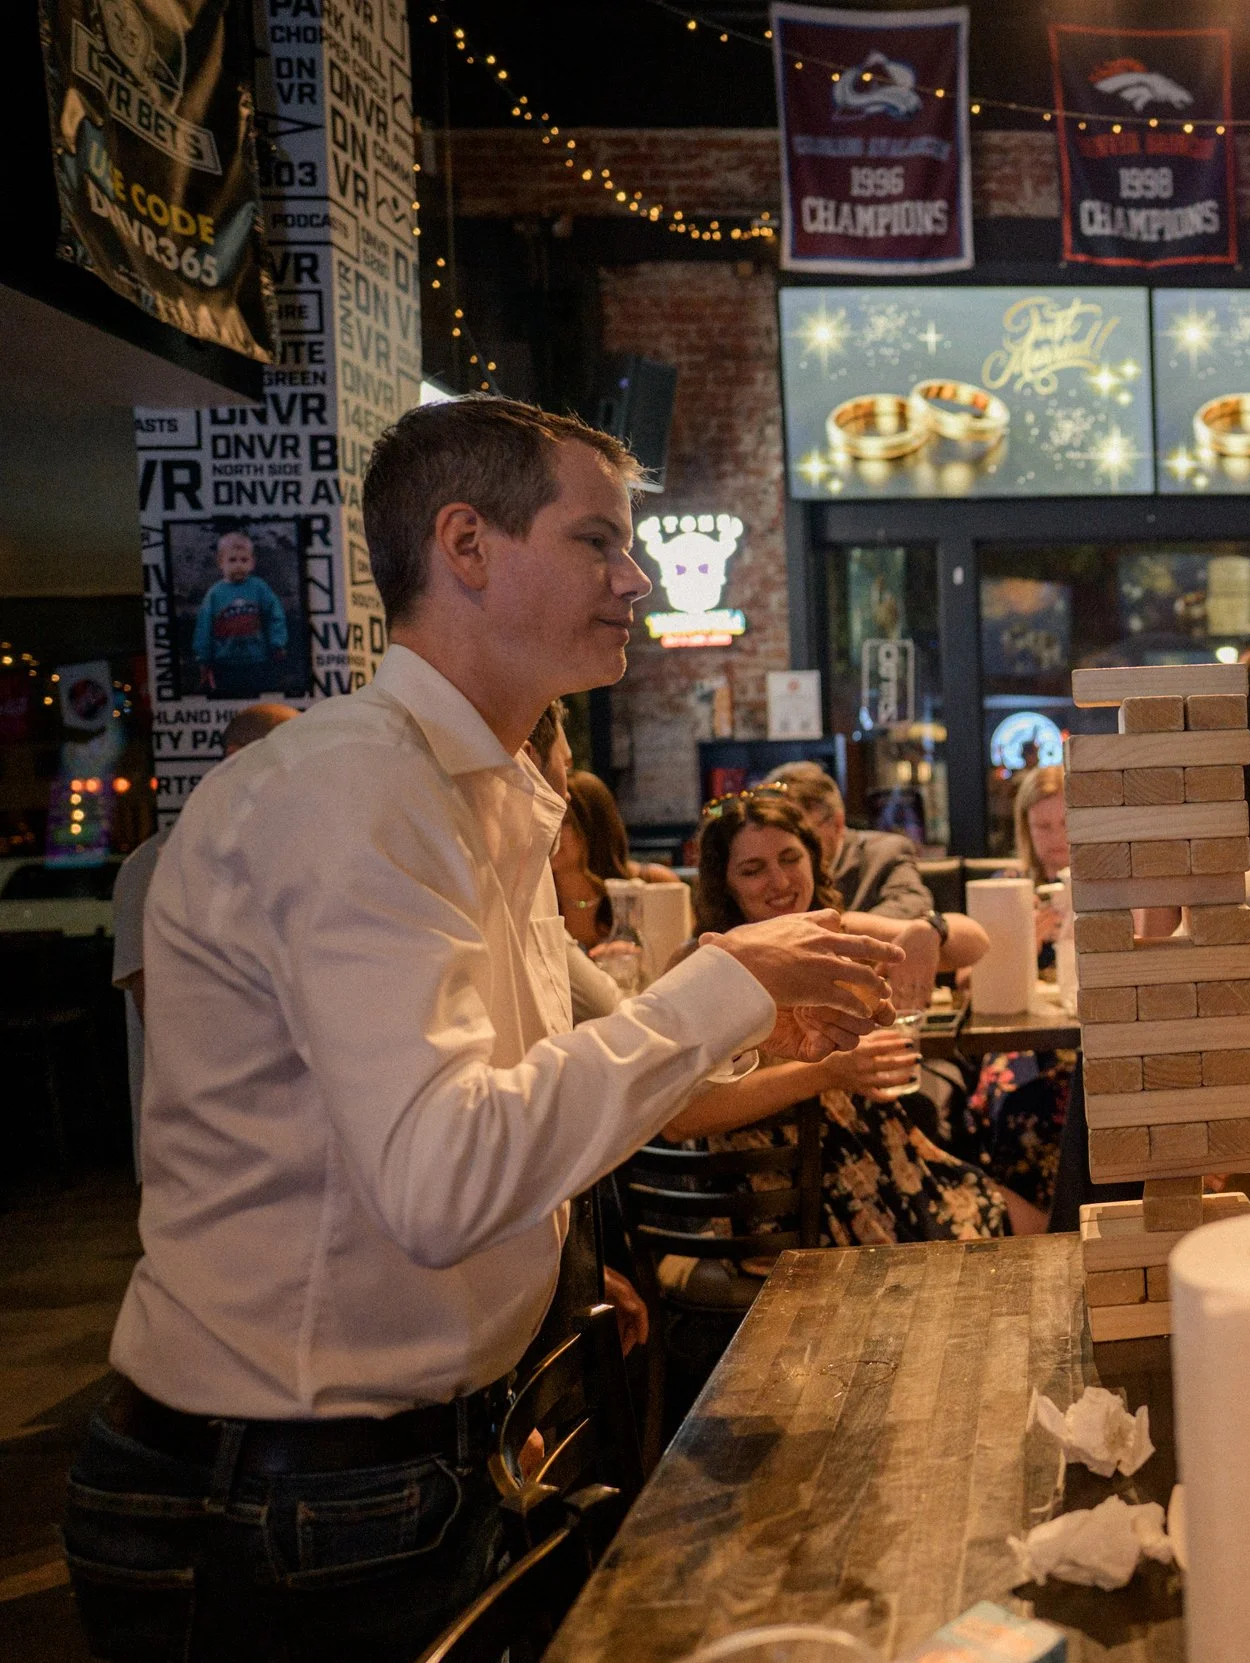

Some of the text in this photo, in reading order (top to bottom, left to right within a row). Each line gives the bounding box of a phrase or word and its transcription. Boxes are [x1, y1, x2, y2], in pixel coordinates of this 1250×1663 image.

[329, 59, 389, 143] DNVR
[137, 100, 204, 161] BETS
[89, 140, 216, 246] UE CODE
[802, 196, 949, 238] CHAMPIONS
[1079, 199, 1221, 242] CHAMPIONS
[211, 433, 300, 460] DNVR
[212, 462, 303, 478] NORTH SIDE
[212, 480, 302, 506] DNVR
[191, 730, 225, 750] PA
